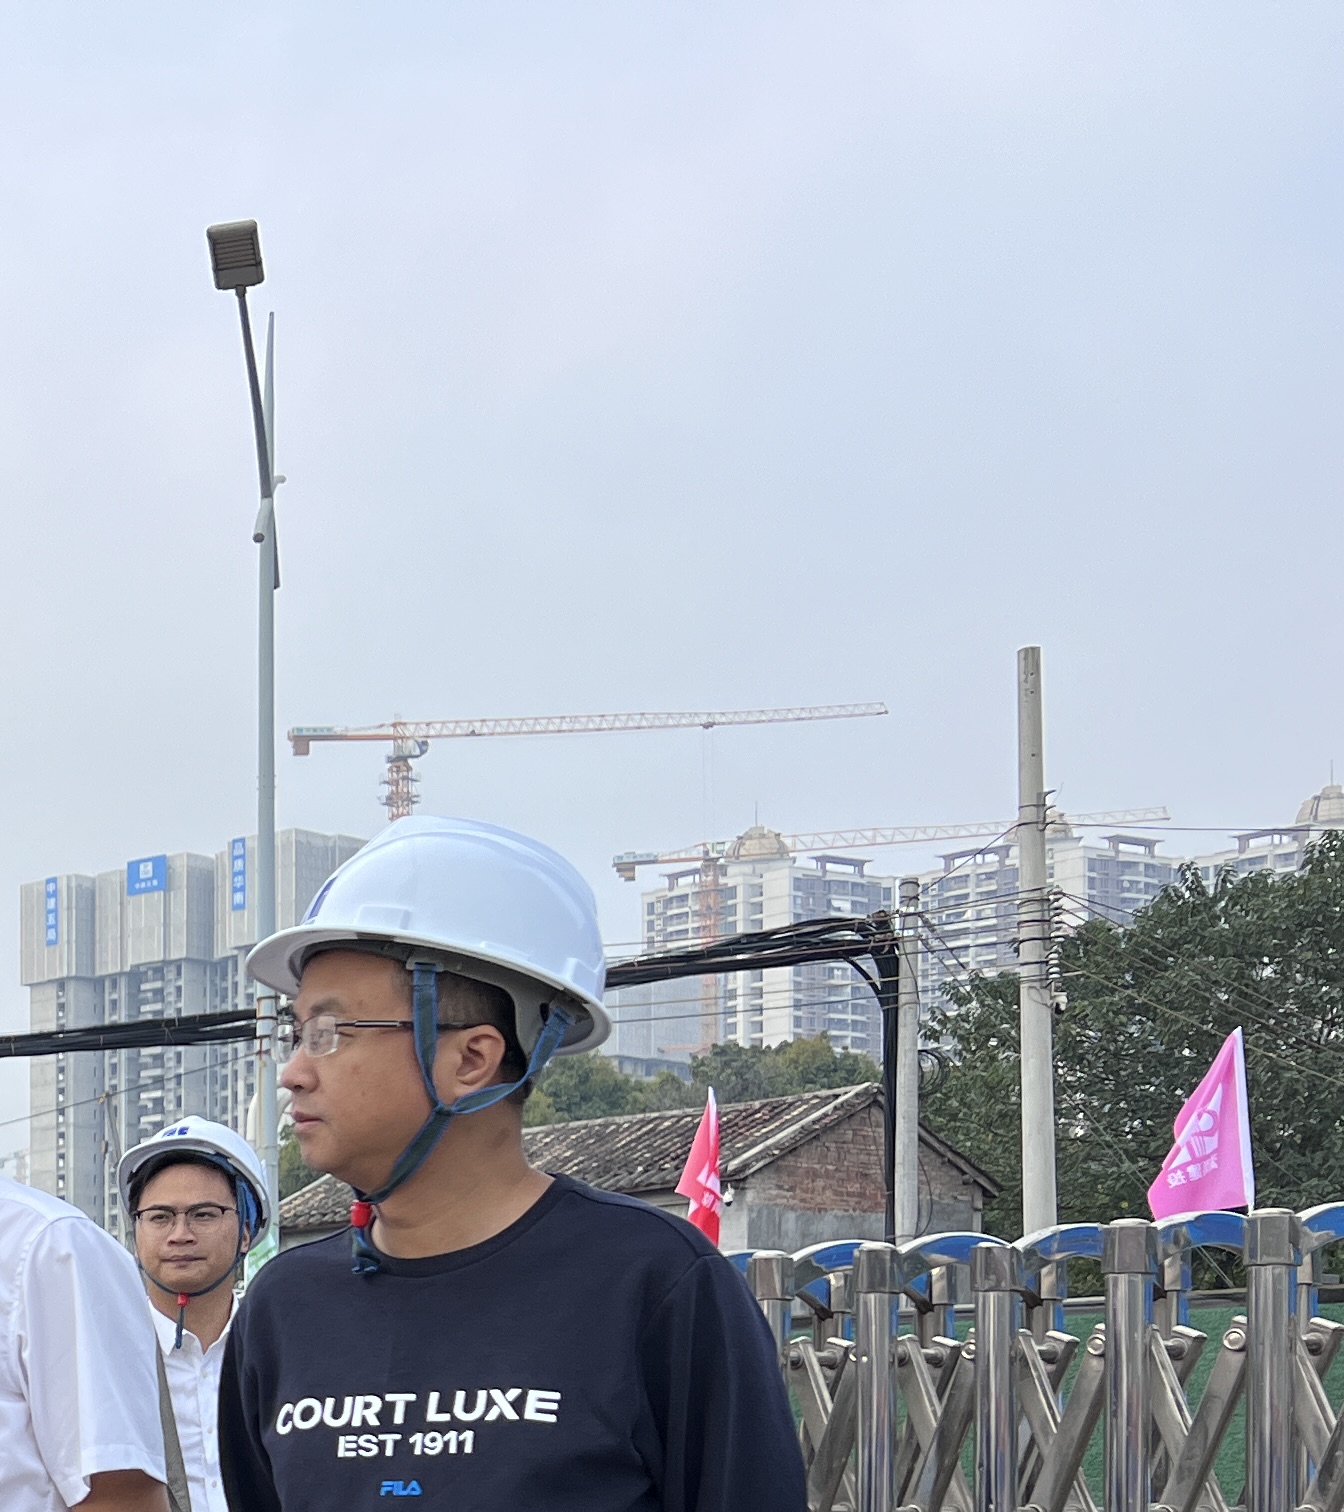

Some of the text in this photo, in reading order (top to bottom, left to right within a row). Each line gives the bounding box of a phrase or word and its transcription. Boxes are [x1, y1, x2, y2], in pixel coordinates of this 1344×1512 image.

[275, 1388, 561, 1435] COURT LUXE
[337, 1429, 474, 1458] EST 1911
[380, 1480, 423, 1497] FILA
